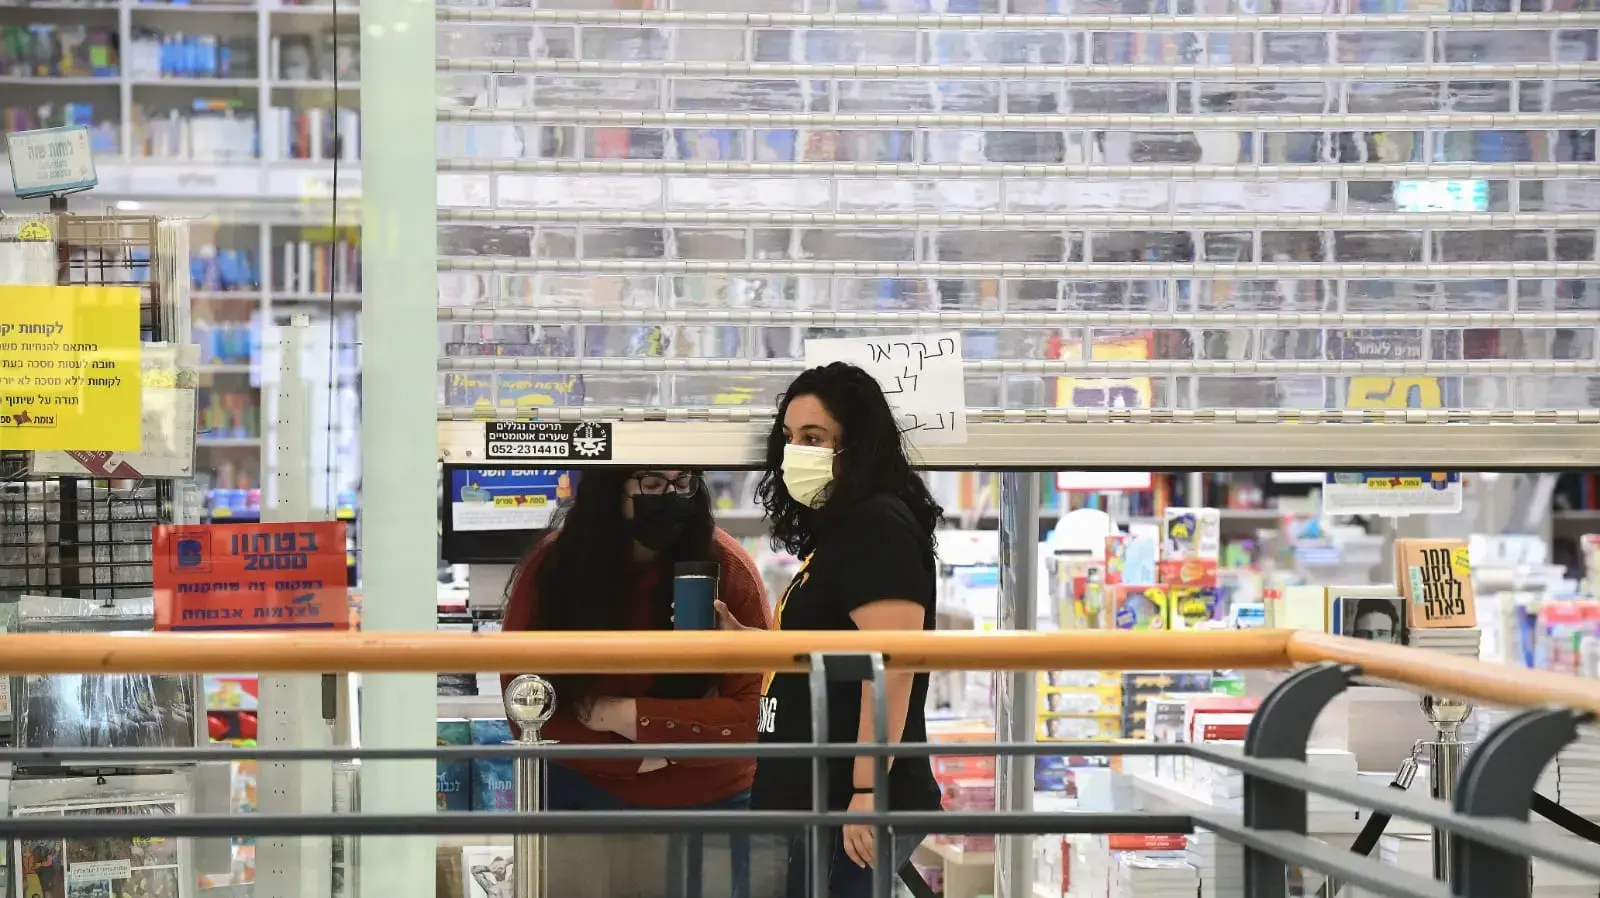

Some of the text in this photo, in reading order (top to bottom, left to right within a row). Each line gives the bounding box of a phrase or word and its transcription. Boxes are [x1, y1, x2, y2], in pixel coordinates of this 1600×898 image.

[0, 321, 64, 337] לקוחות יק
[0, 341, 98, 352] בהתאם להנחיות מש
[867, 338, 954, 371] תקראו
[58, 359, 88, 369] לעטות
[0, 375, 121, 388] לקוחות ללא מסכה לא יור
[6, 395, 79, 406] תודה על שיתוף
[0, 415, 54, 424] צומת ספ
[898, 412, 955, 433] ונב
[496, 420, 526, 431] נגללים
[529, 422, 562, 431] תריסים
[489, 432, 569, 441] שערים אוטומטיים
[491, 444, 566, 455] 052-2314416
[232, 531, 319, 555] בטחון
[243, 552, 308, 570] 2000
[248, 581, 267, 592] זה
[1424, 598, 1466, 621] פארק
